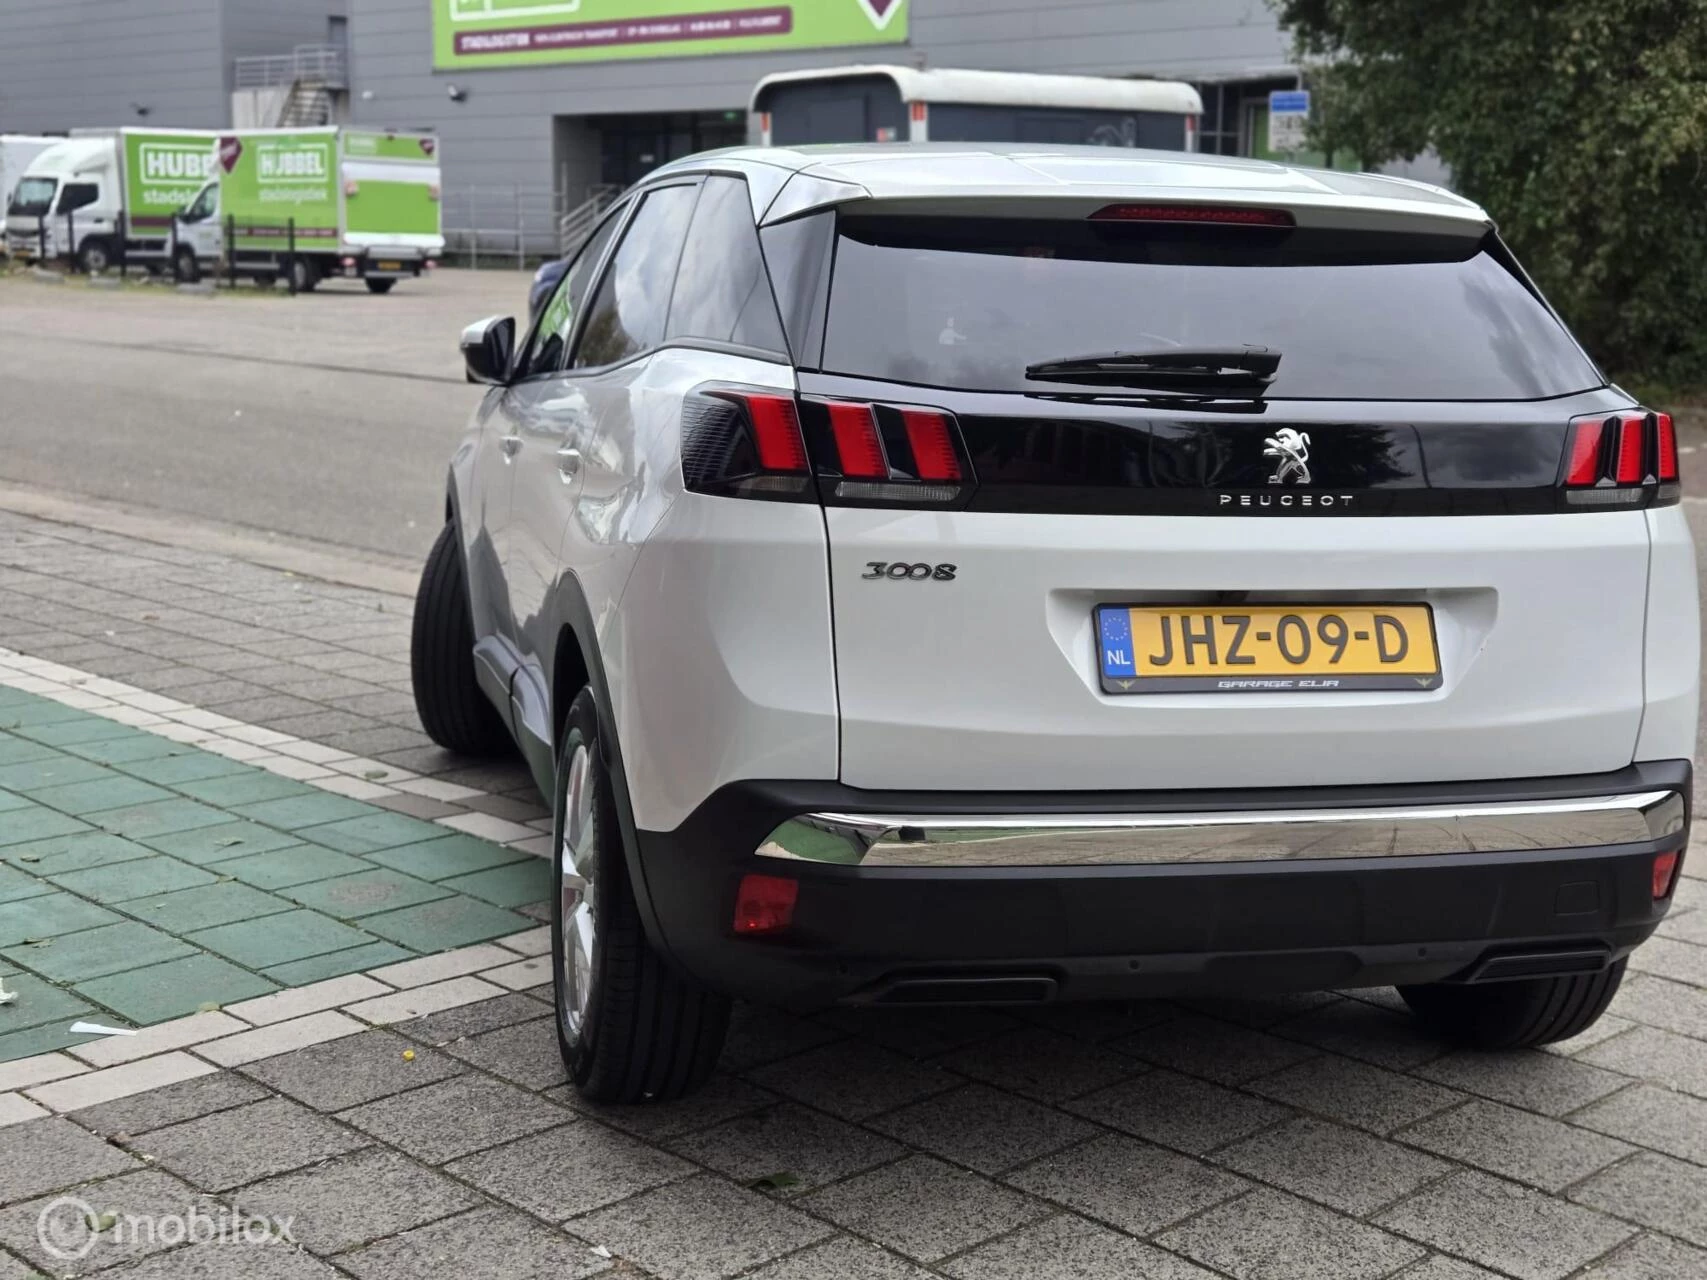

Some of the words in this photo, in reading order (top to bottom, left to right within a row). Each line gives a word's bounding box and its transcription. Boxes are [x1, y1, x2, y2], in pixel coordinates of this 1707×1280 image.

[1219, 494, 1353, 506] PEUGEOT
[862, 562, 957, 581] 3008
[1149, 614, 1409, 665] JHZ-09-D
[1108, 650, 1131, 666] NL
[1218, 680, 1293, 689] GARAGE
